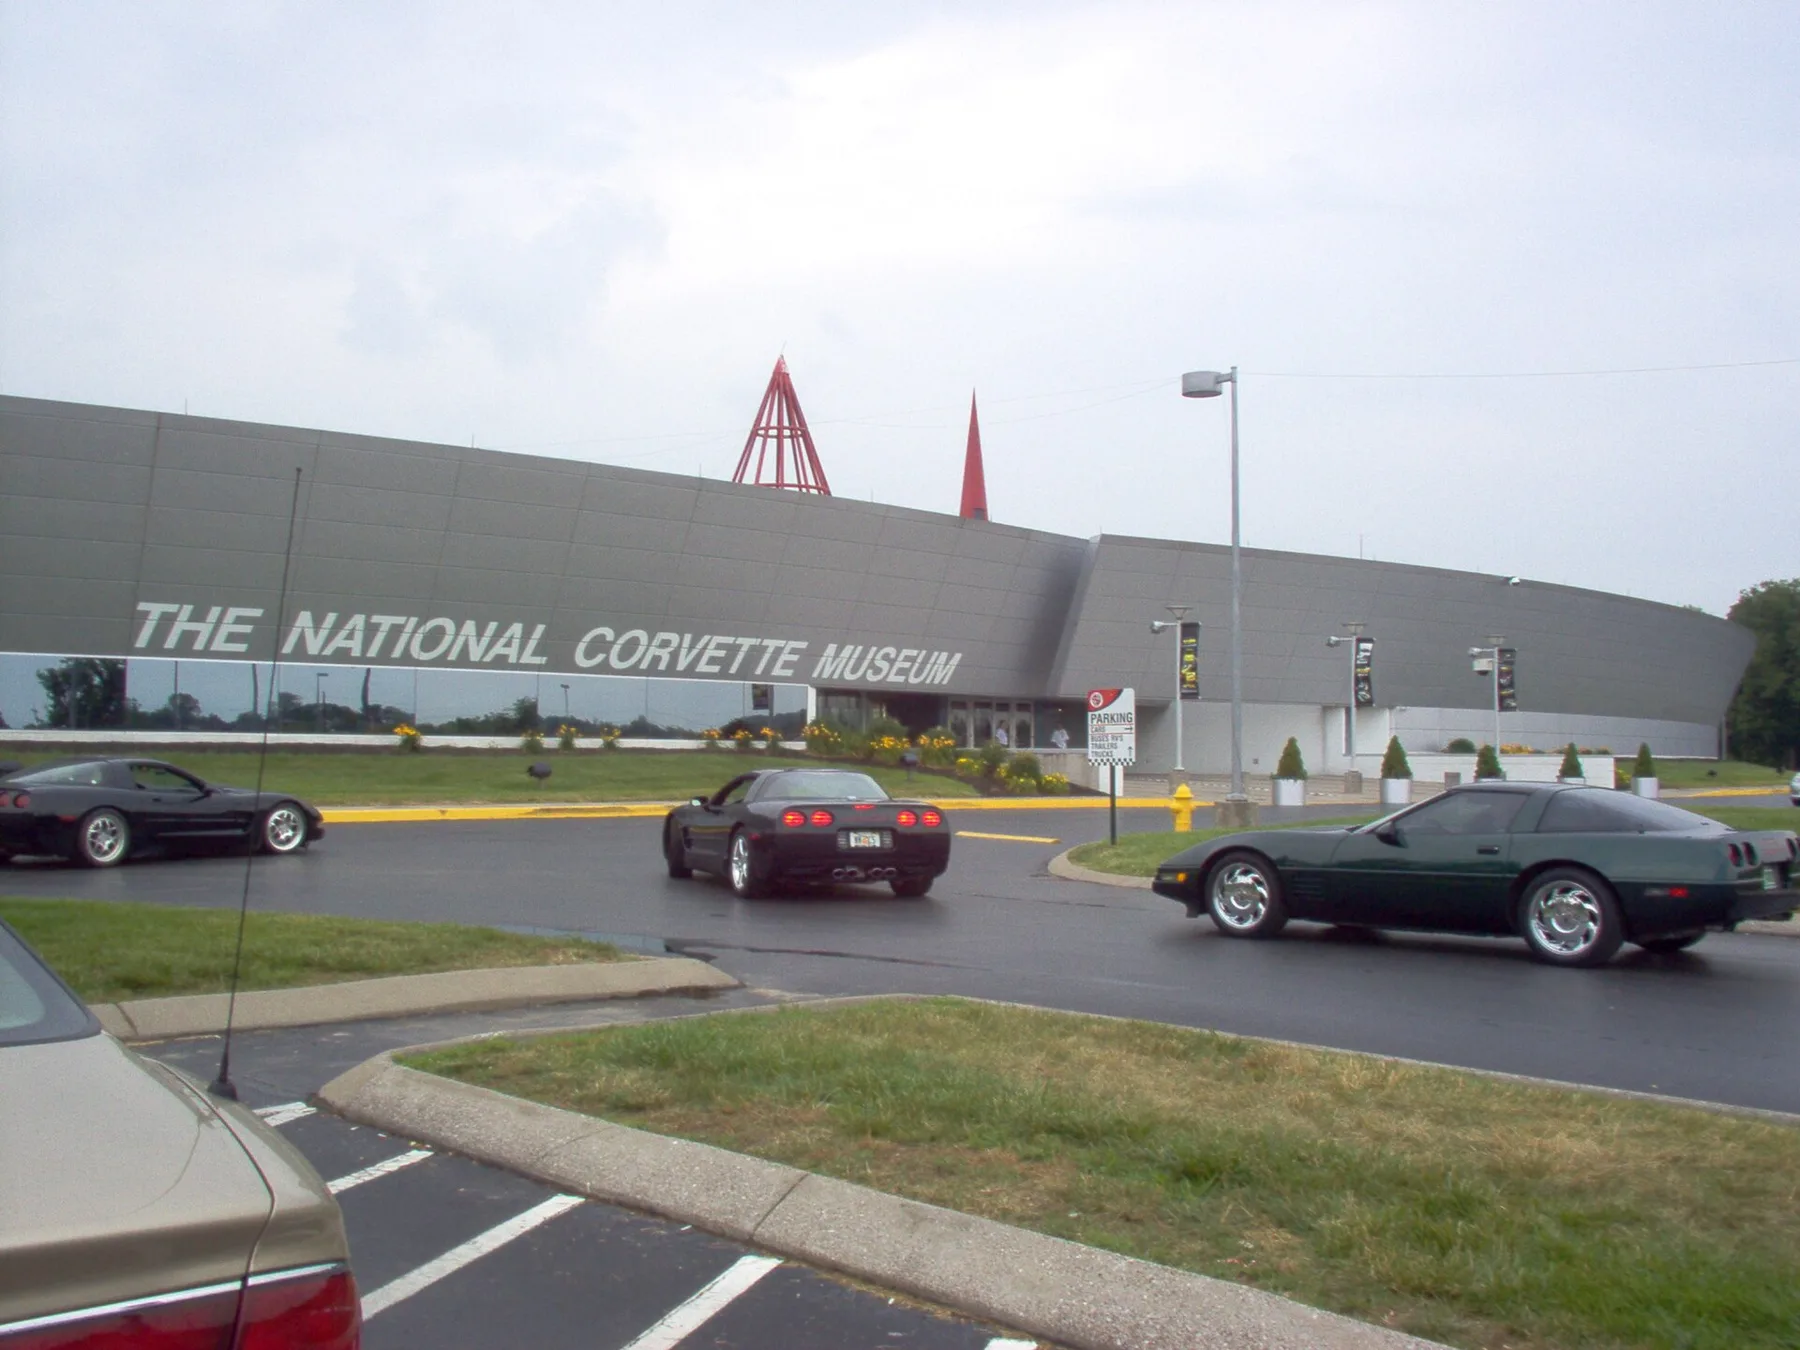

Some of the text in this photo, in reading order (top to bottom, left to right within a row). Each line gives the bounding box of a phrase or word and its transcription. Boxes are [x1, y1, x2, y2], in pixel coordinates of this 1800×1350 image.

[134, 602, 962, 685] THE NATIONAL CORVETTE MUSEUM
[1090, 712, 1133, 724] PARKING
[1090, 742, 1118, 750] TRAILERS
[1090, 750, 1113, 758] TRUCKS
